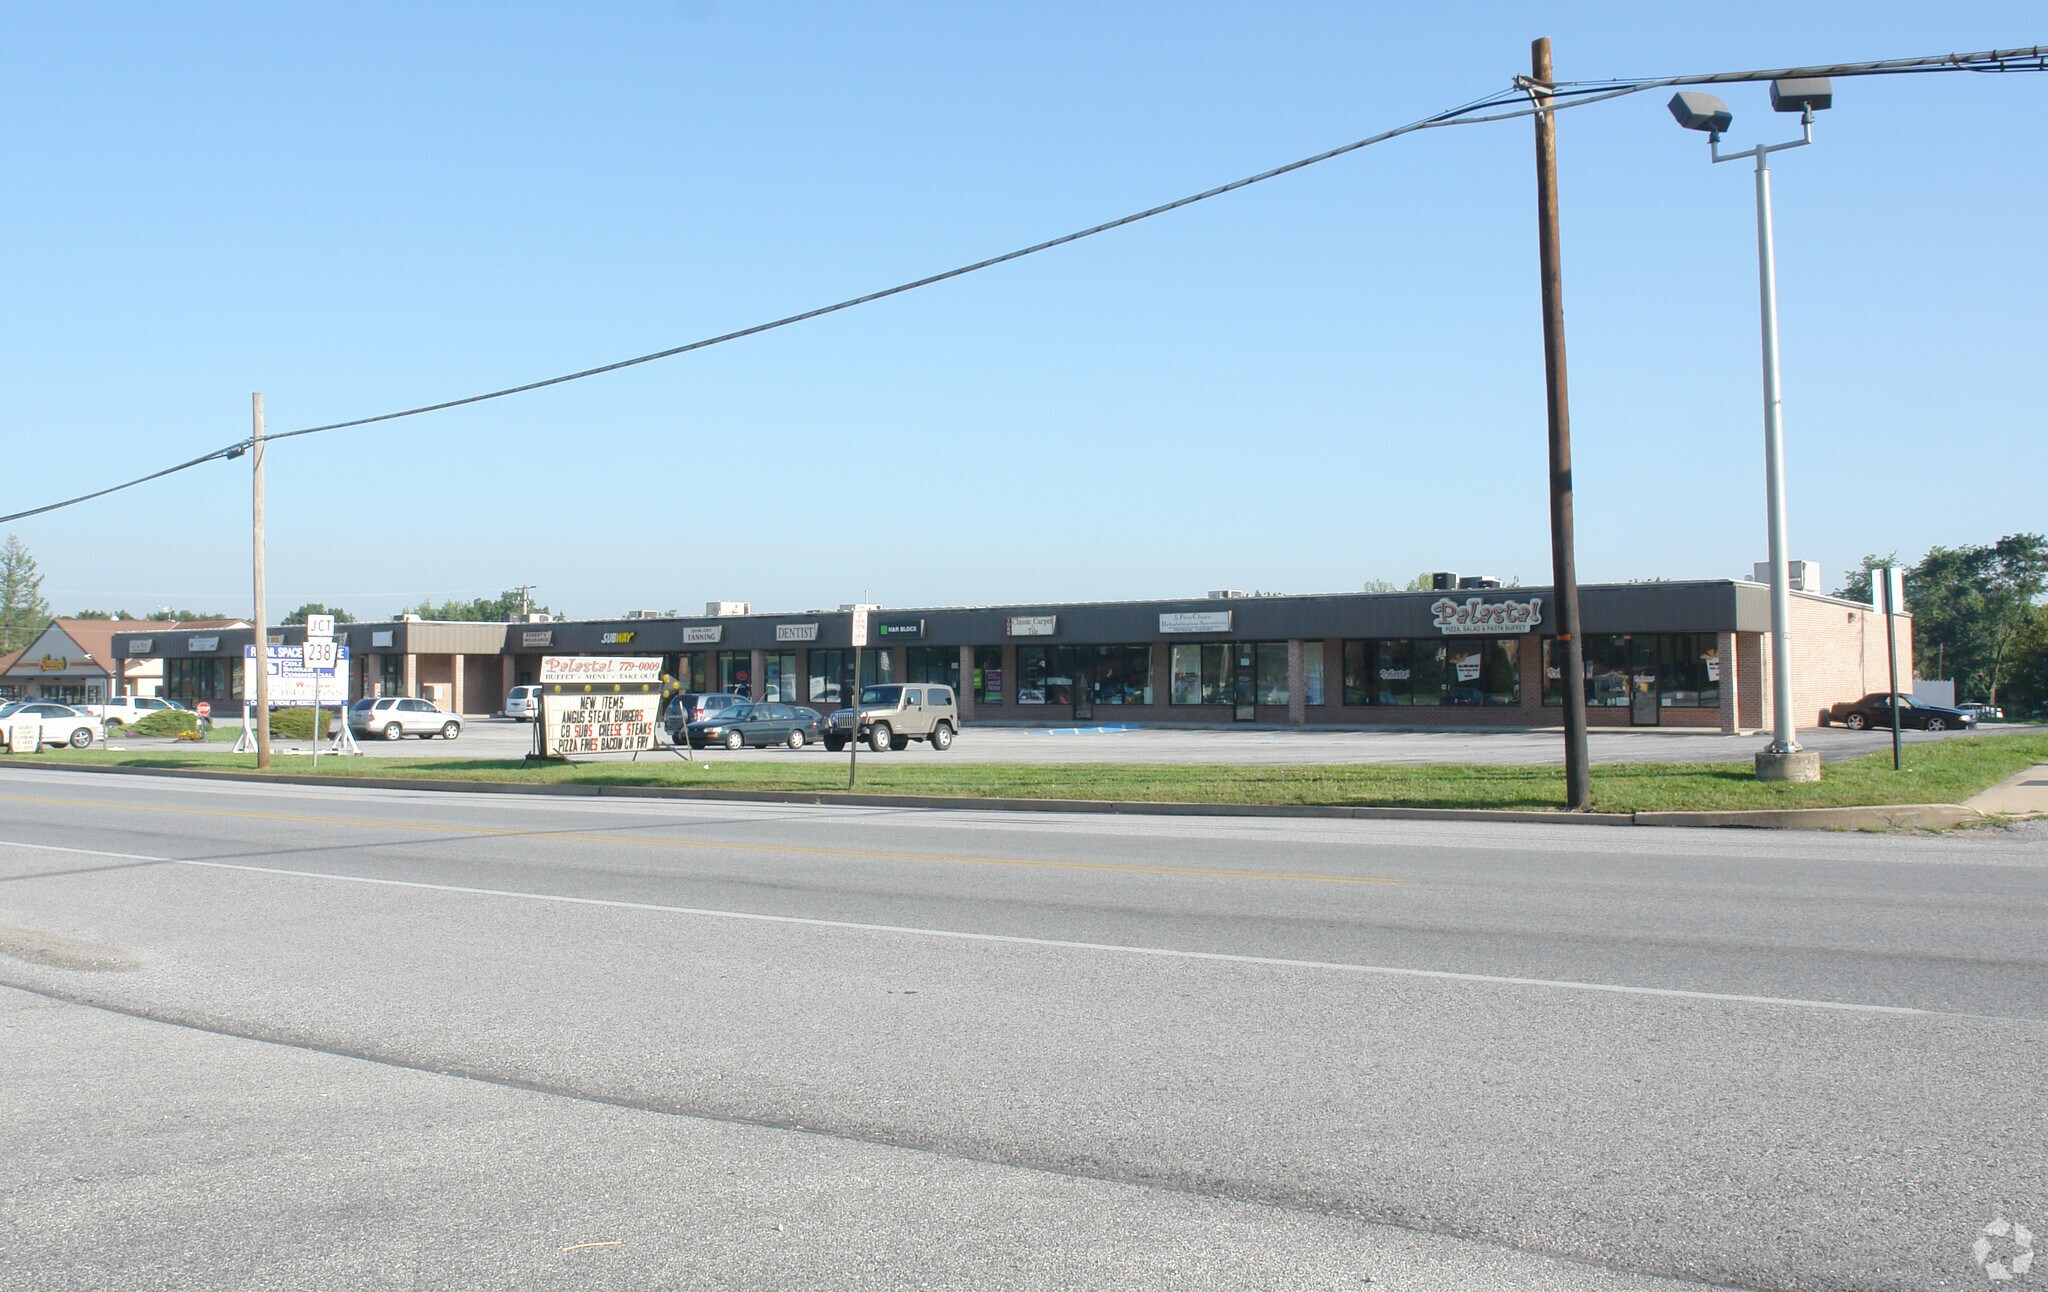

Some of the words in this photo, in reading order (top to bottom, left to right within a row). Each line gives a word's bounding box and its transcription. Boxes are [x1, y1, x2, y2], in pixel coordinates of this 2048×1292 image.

[1433, 600, 1539, 624] Palasta!
[311, 620, 331, 631] JCT
[601, 632, 635, 644] SUBWAY
[687, 633, 715, 641] TANNING
[778, 627, 813, 639] DENTIST
[250, 646, 277, 658] RAIL
[277, 647, 303, 658] SPACE
[308, 644, 331, 661] 238
[545, 658, 614, 673] Palasta!
[620, 661, 660, 672] 779-0009
[580, 696, 597, 709] NEW
[602, 696, 624, 709] ITEMS
[562, 710, 586, 724] ANGUS
[588, 710, 611, 723] STEAK
[614, 709, 644, 722] BURGERS
[574, 724, 593, 737] SUBS
[599, 724, 622, 736] CHEESE
[626, 722, 652, 735] STEAKS
[559, 739, 578, 752] PIZZA
[580, 738, 598, 751] FRIES
[601, 737, 622, 751] BACON
[637, 736, 649, 749] FRY
